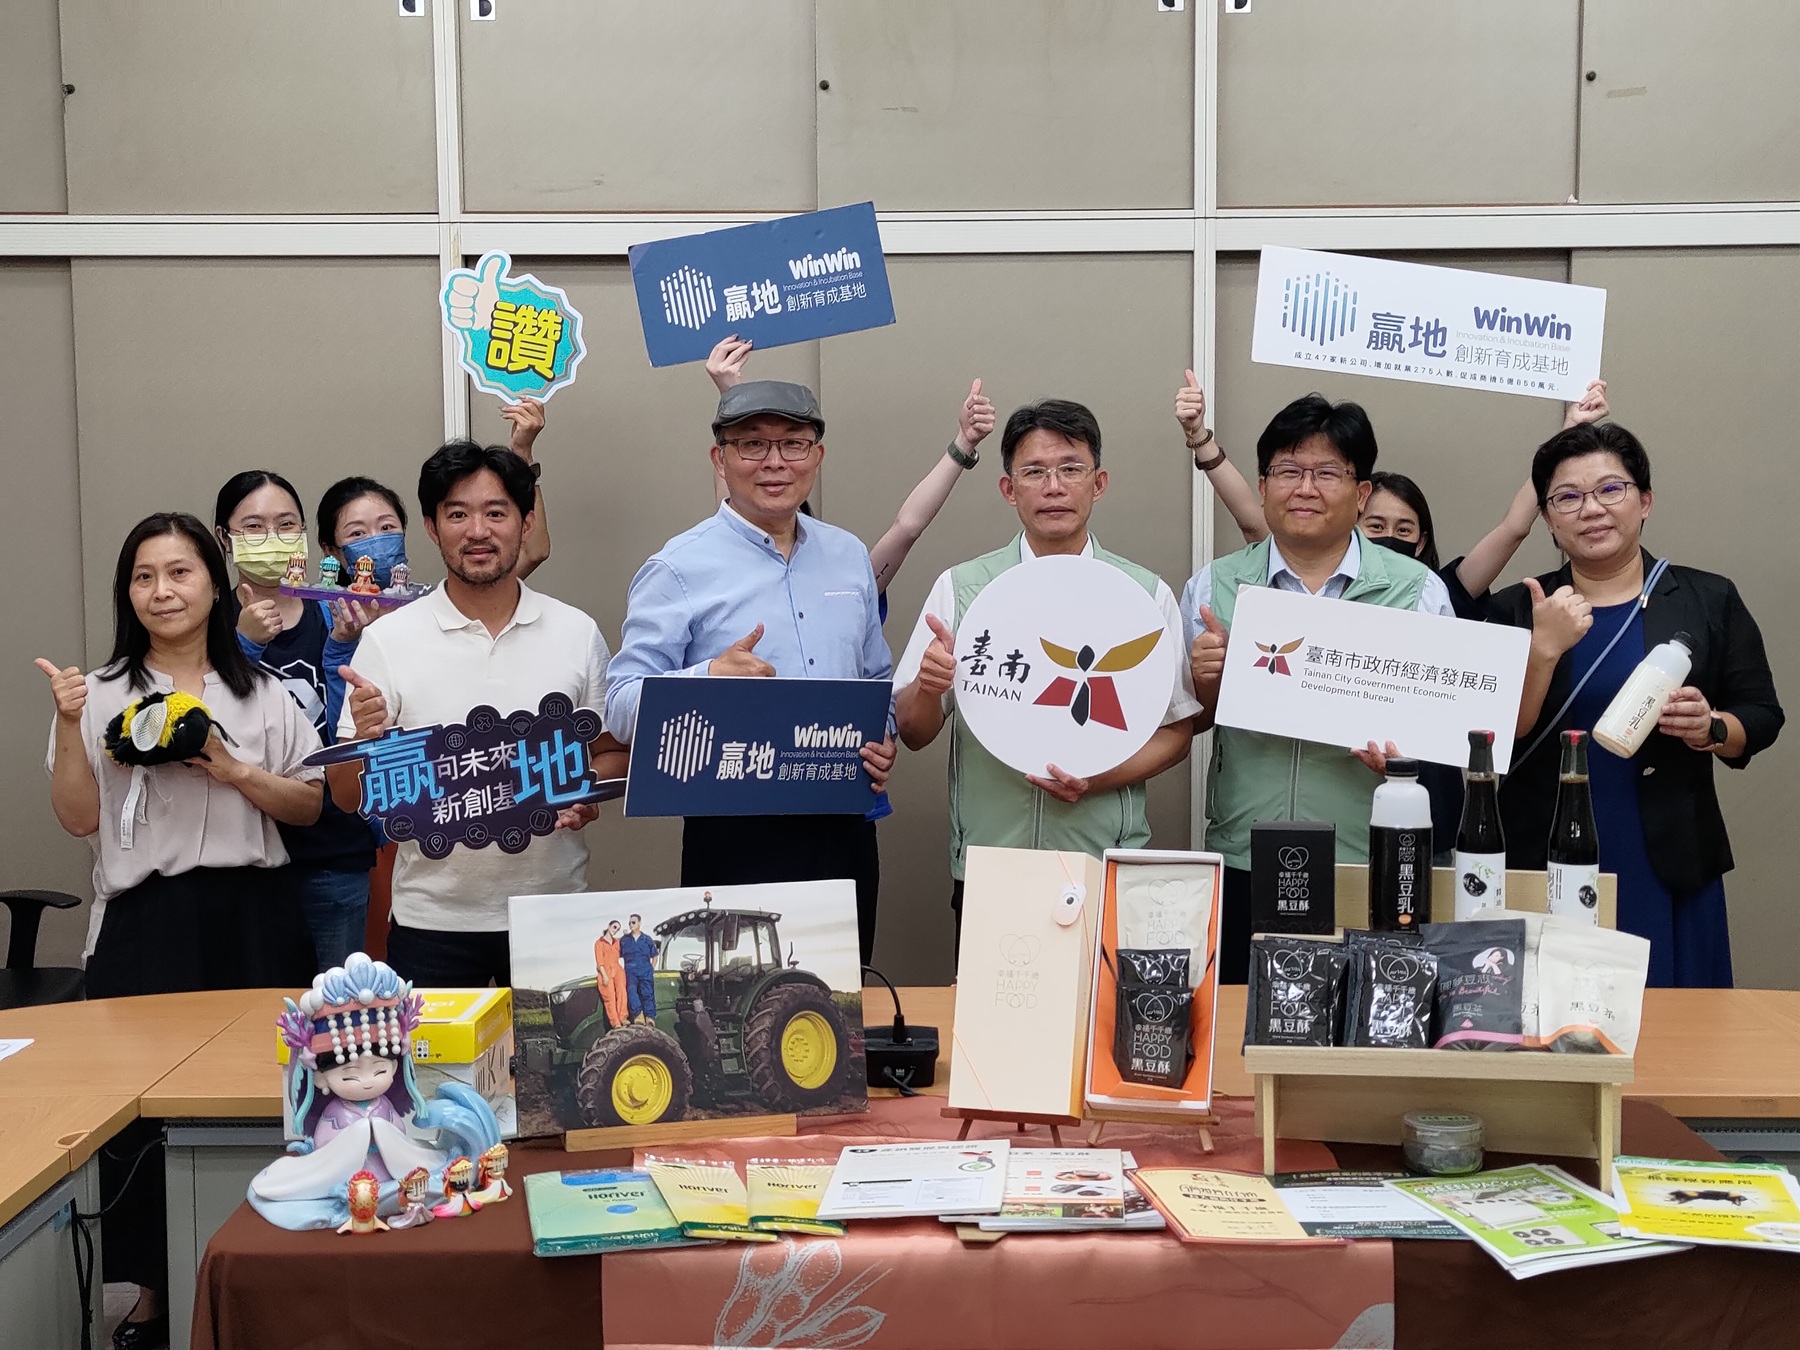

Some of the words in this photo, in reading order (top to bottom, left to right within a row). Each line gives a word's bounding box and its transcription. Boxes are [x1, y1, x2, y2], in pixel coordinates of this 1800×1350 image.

[788, 246, 862, 280] WinWin
[782, 280, 814, 292] Innovation
[818, 273, 849, 285] Incubation
[848, 271, 863, 280] Base
[723, 278, 783, 323] 贏地
[785, 281, 867, 313] 創新育成基地
[1366, 311, 1448, 358] 贏地
[1473, 305, 1572, 341] WinWin
[487, 301, 563, 380] 讚
[1456, 330, 1498, 344] Innovation
[1507, 336, 1550, 350] Incubation
[1550, 343, 1571, 353] Base
[1454, 343, 1570, 377] 創新育成基地
[960, 629, 1031, 684] 臺南
[1304, 645, 1498, 694] 臺南市政府經濟發展局
[961, 679, 1022, 702] TAINAN
[1300, 680, 1361, 698] Development
[1363, 691, 1395, 704] Bureau
[1303, 667, 1332, 680] Tainan
[1334, 673, 1352, 685] City
[1354, 676, 1411, 694] Government
[1413, 686, 1457, 701] Economic
[1628, 695, 1656, 730] 黑豆乳
[794, 722, 863, 749] WinWin
[432, 740, 517, 782] 向未來
[509, 728, 592, 805] 地
[716, 740, 776, 780] 贏地
[779, 750, 811, 759] Innovation
[815, 750, 845, 759] Incubation
[357, 729, 445, 815] 贏
[777, 762, 857, 781] 創新育成基地
[431, 779, 517, 826] 新創基
[1278, 878, 1309, 887] HAPPY
[1278, 887, 1310, 899] FOOD
[1397, 863, 1415, 914] 黑豆乳
[1277, 899, 1310, 911] 黑豆酥
[1147, 919, 1186, 931] HAPPY
[995, 991, 1039, 1009] FOOD
[996, 979, 1040, 992] HAPPY
[1134, 1031, 1172, 1045] HAPPY
[1268, 1018, 1311, 1034] 黑豆酥
[1133, 1042, 1172, 1059] FOOD
[1131, 1057, 1171, 1075] 黑豆酥
